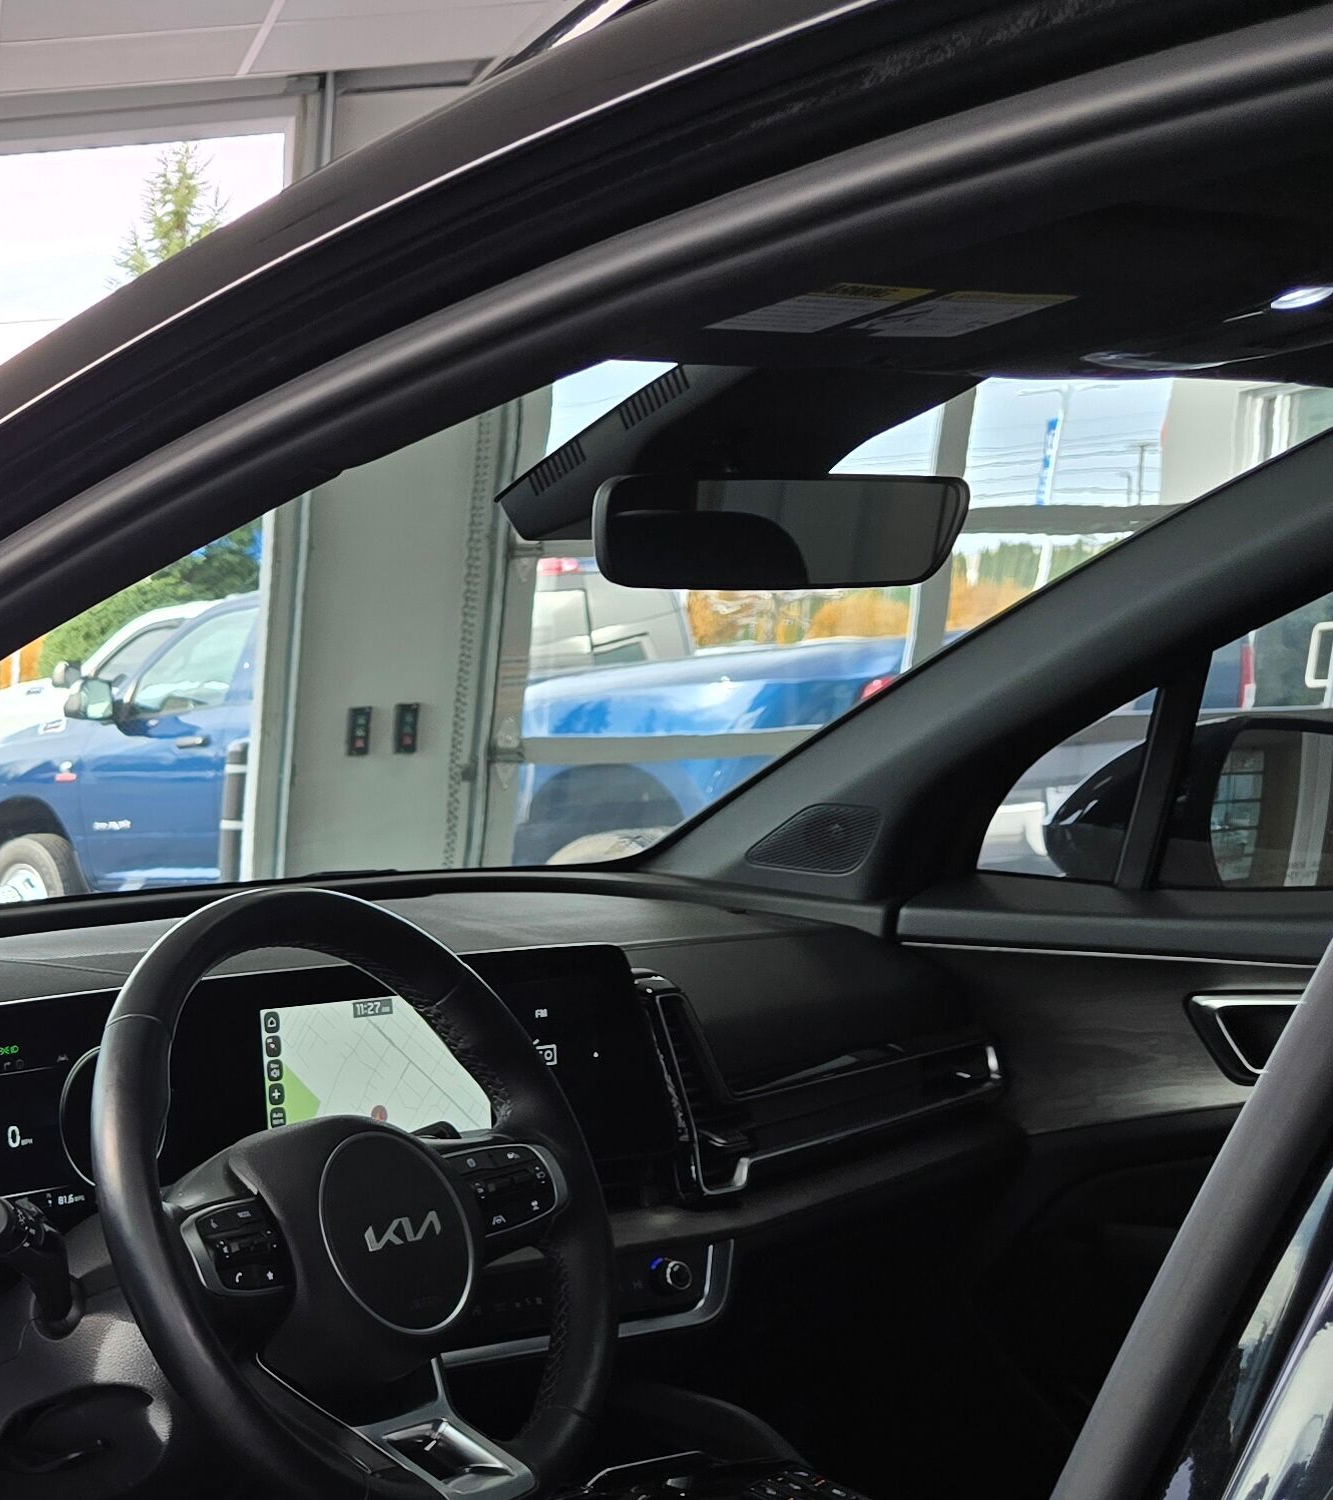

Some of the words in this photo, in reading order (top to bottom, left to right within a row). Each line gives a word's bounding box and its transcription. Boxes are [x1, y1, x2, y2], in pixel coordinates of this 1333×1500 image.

[355, 1001, 381, 1016] 11:27
[7, 1125, 21, 1148] 0
[364, 1210, 442, 1252] KIA
